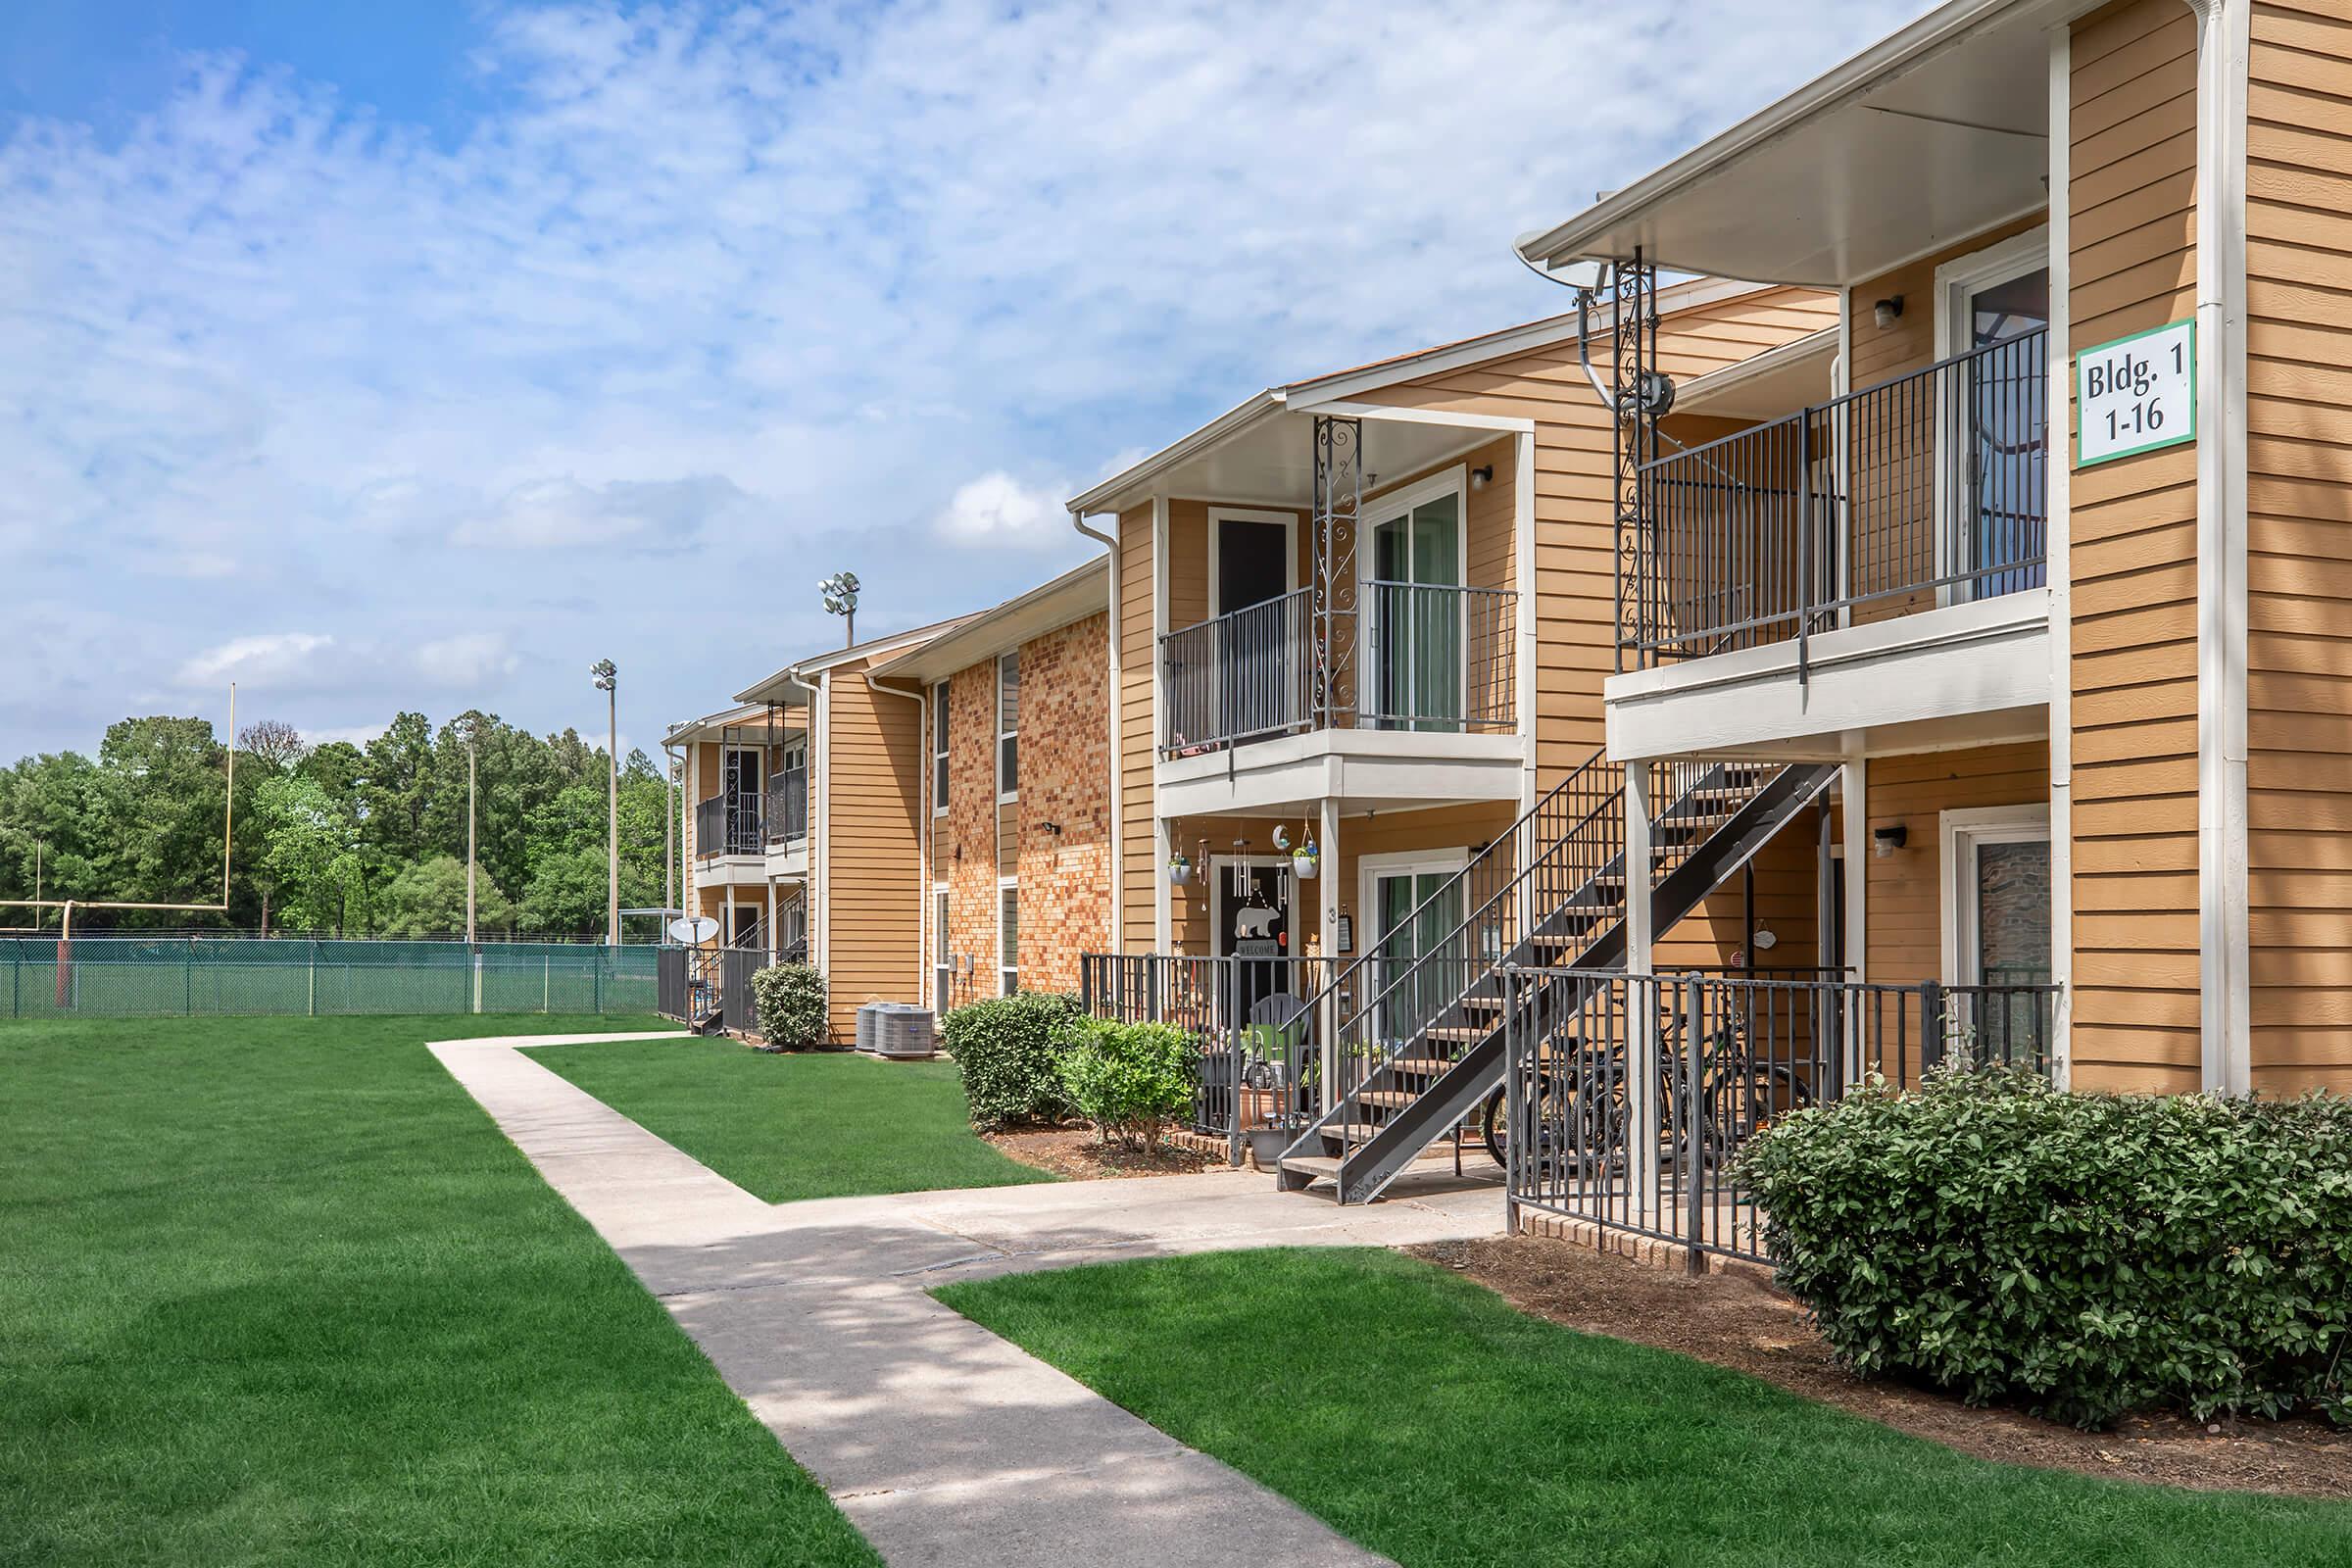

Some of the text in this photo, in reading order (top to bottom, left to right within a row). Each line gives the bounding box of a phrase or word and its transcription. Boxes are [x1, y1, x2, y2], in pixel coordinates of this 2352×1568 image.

[2087, 341, 2182, 399] Bldg. 1
[2105, 397, 2164, 440] 1-16
[1328, 907, 1337, 924] 3
